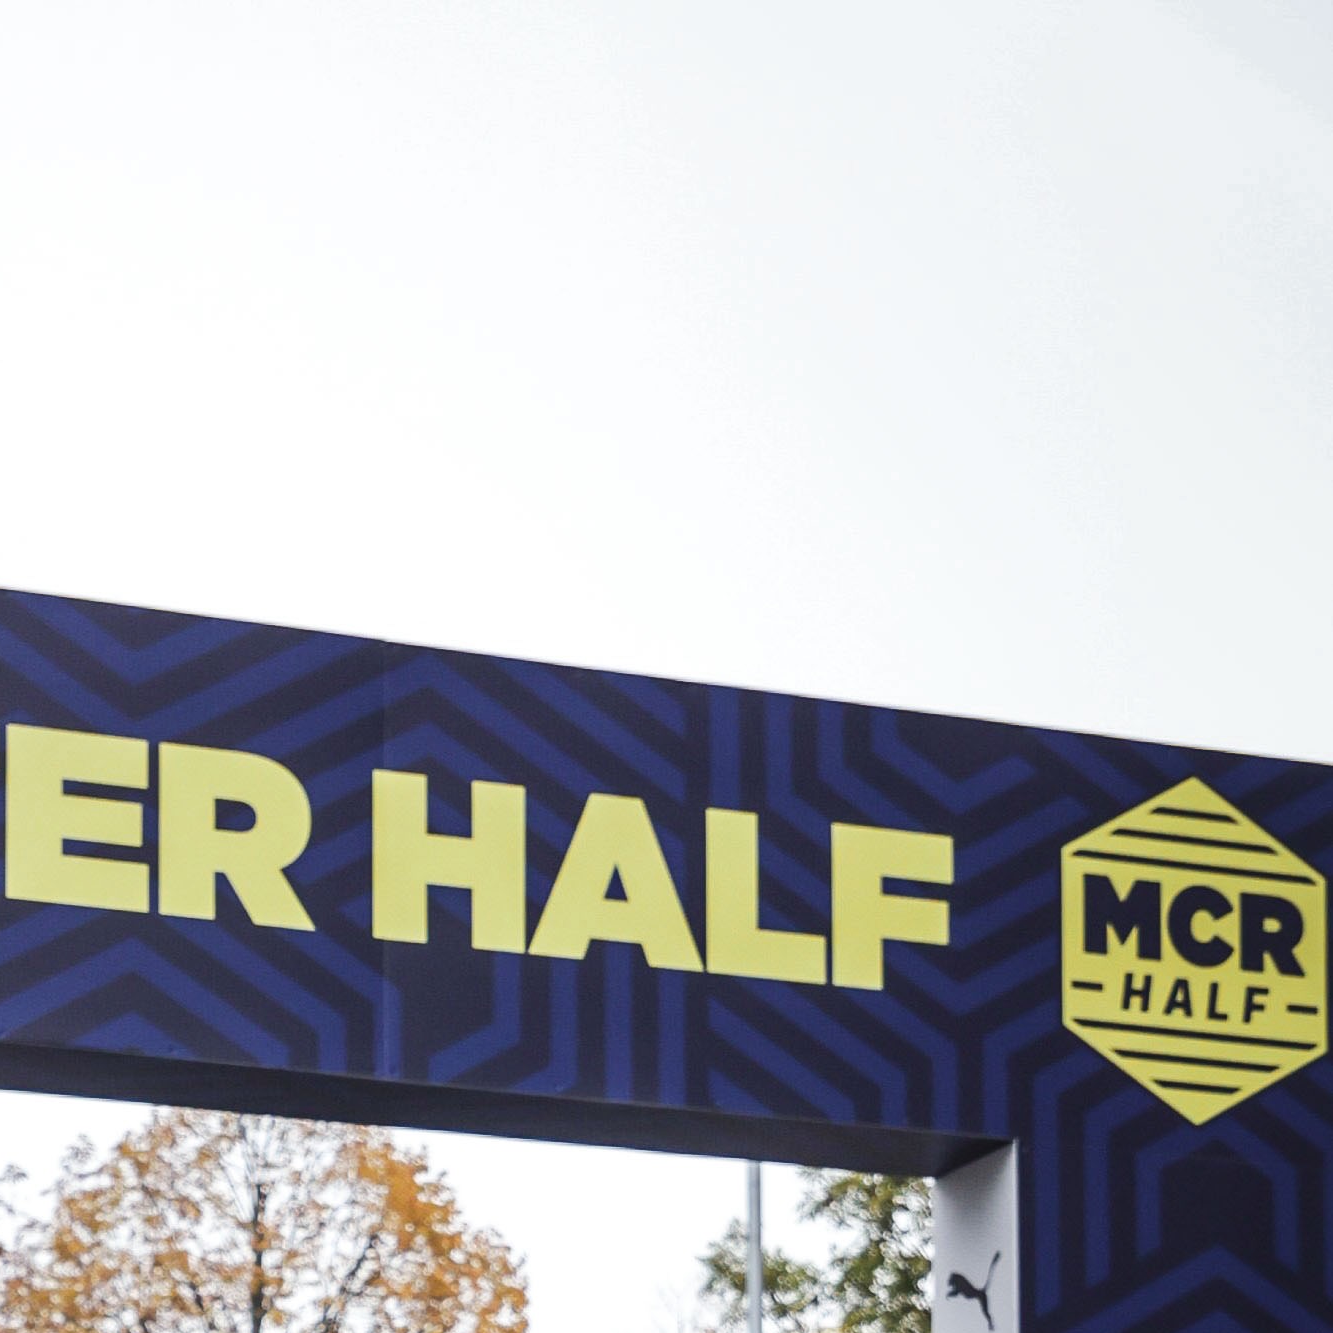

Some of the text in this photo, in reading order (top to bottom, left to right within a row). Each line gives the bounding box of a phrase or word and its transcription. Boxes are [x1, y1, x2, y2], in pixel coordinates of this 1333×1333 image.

[372, 767, 954, 990] HALF
[1082, 873, 1305, 978] MCR
[1121, 972, 1269, 1024] HALF
